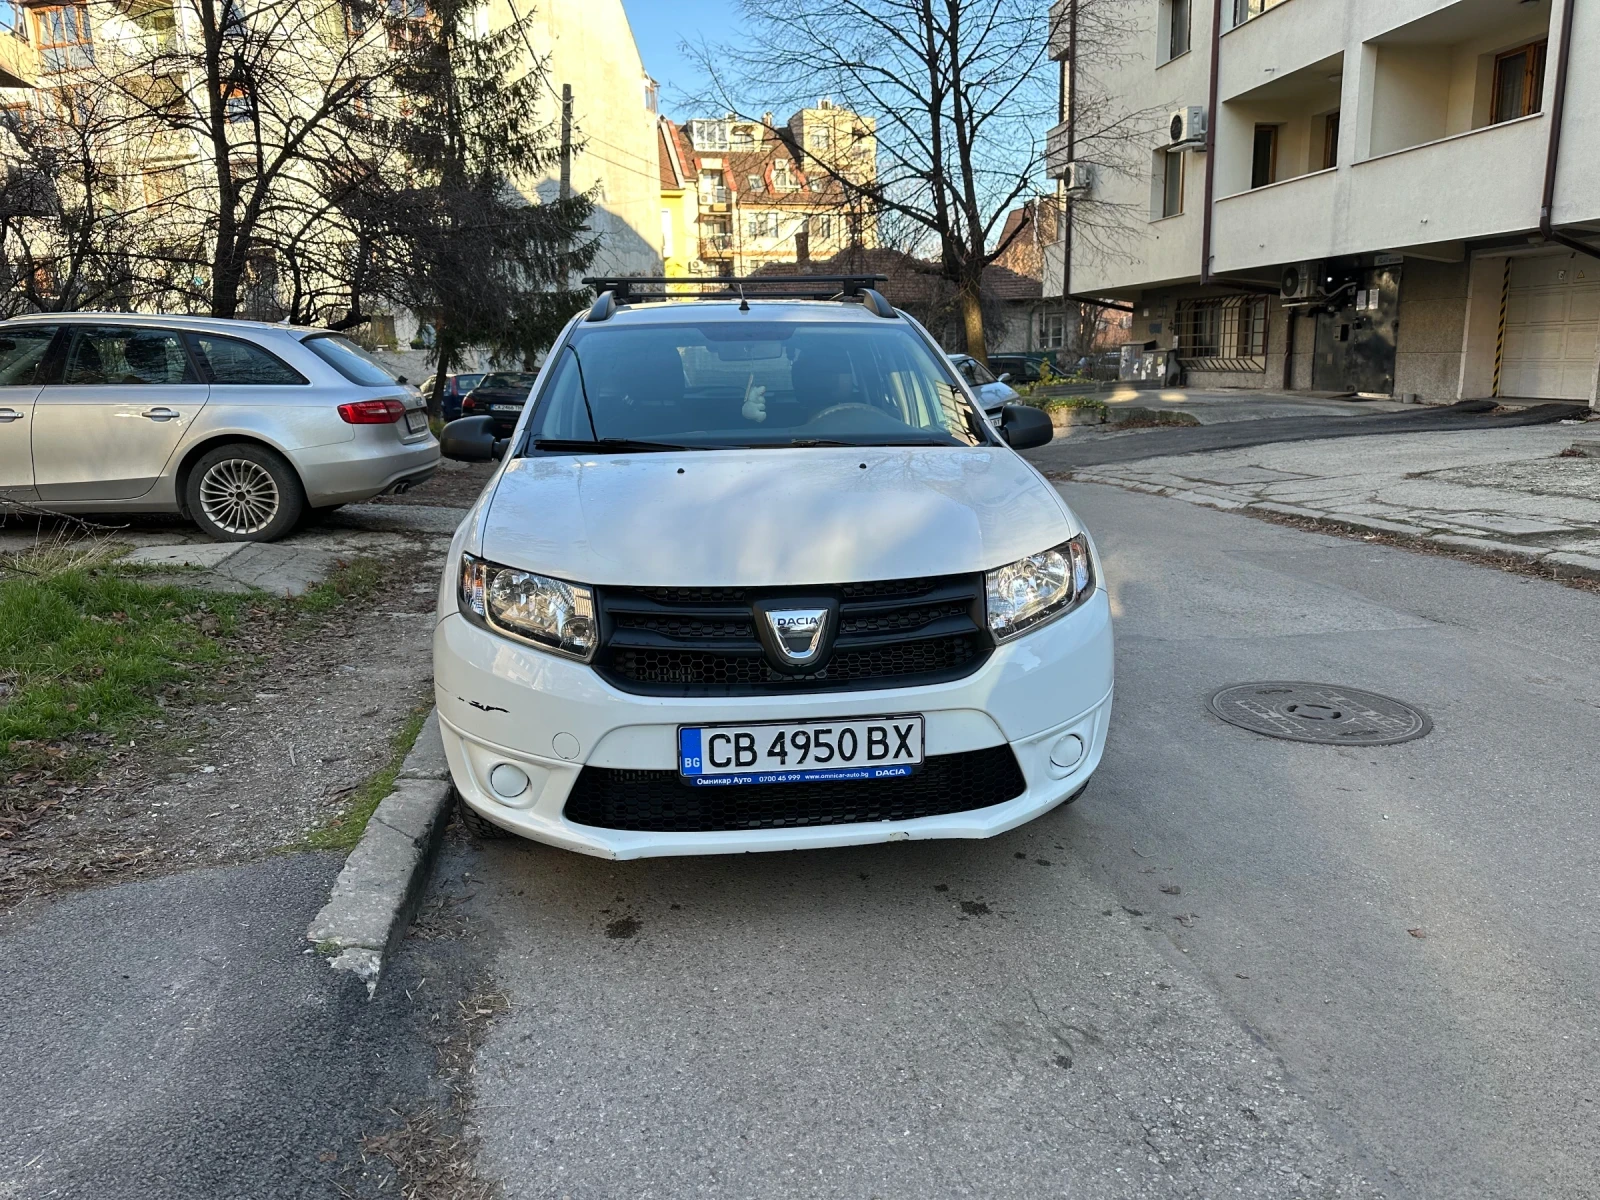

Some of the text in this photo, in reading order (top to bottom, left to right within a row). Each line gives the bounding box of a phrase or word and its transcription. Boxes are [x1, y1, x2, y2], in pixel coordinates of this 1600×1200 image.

[777, 617, 819, 626] DACIA
[708, 723, 914, 768] CB 4950 BX
[684, 757, 700, 768] BG
[696, 777, 732, 785] Омникар
[733, 776, 752, 785] Ауто
[788, 773, 801, 781] 999
[805, 771, 869, 780] www.omnicar-auto.bg
[875, 768, 906, 777] DACIA
